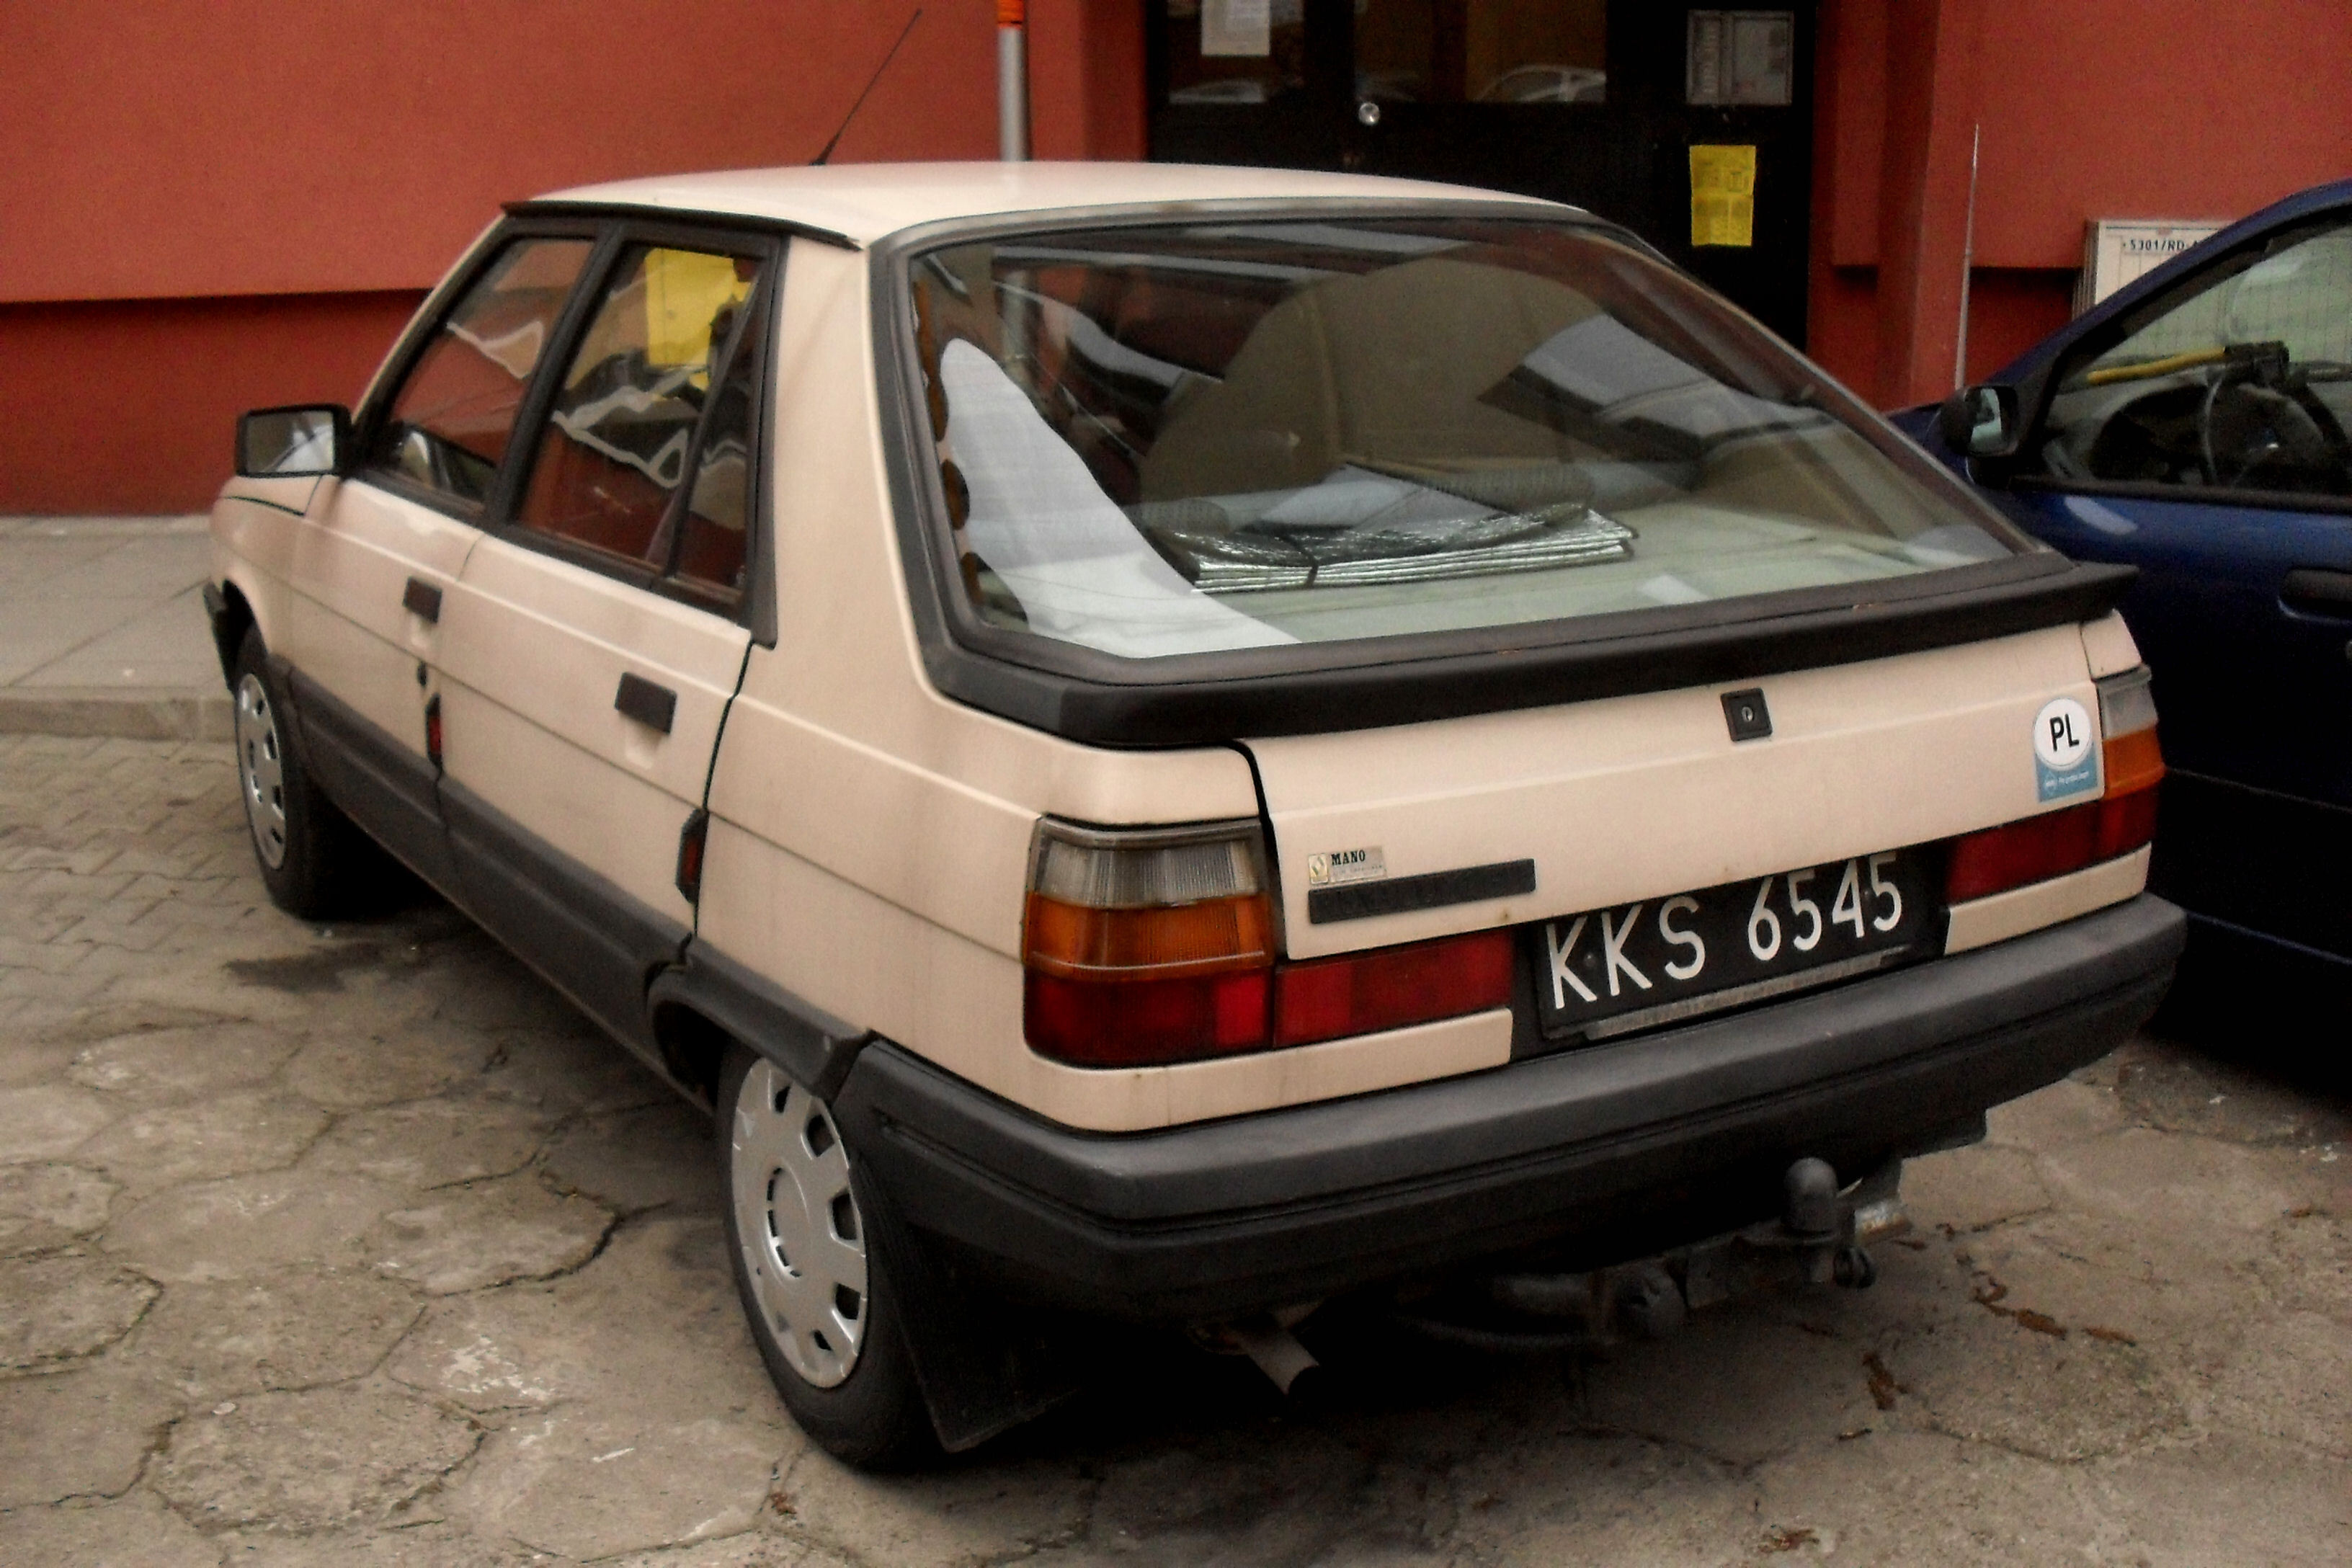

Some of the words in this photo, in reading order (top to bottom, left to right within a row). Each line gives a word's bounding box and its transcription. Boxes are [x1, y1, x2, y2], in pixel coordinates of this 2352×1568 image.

[2049, 713, 2080, 752] PL
[1331, 850, 1366, 865] MANO
[1546, 896, 1706, 1009] KKS
[1747, 852, 1902, 961] 6545
